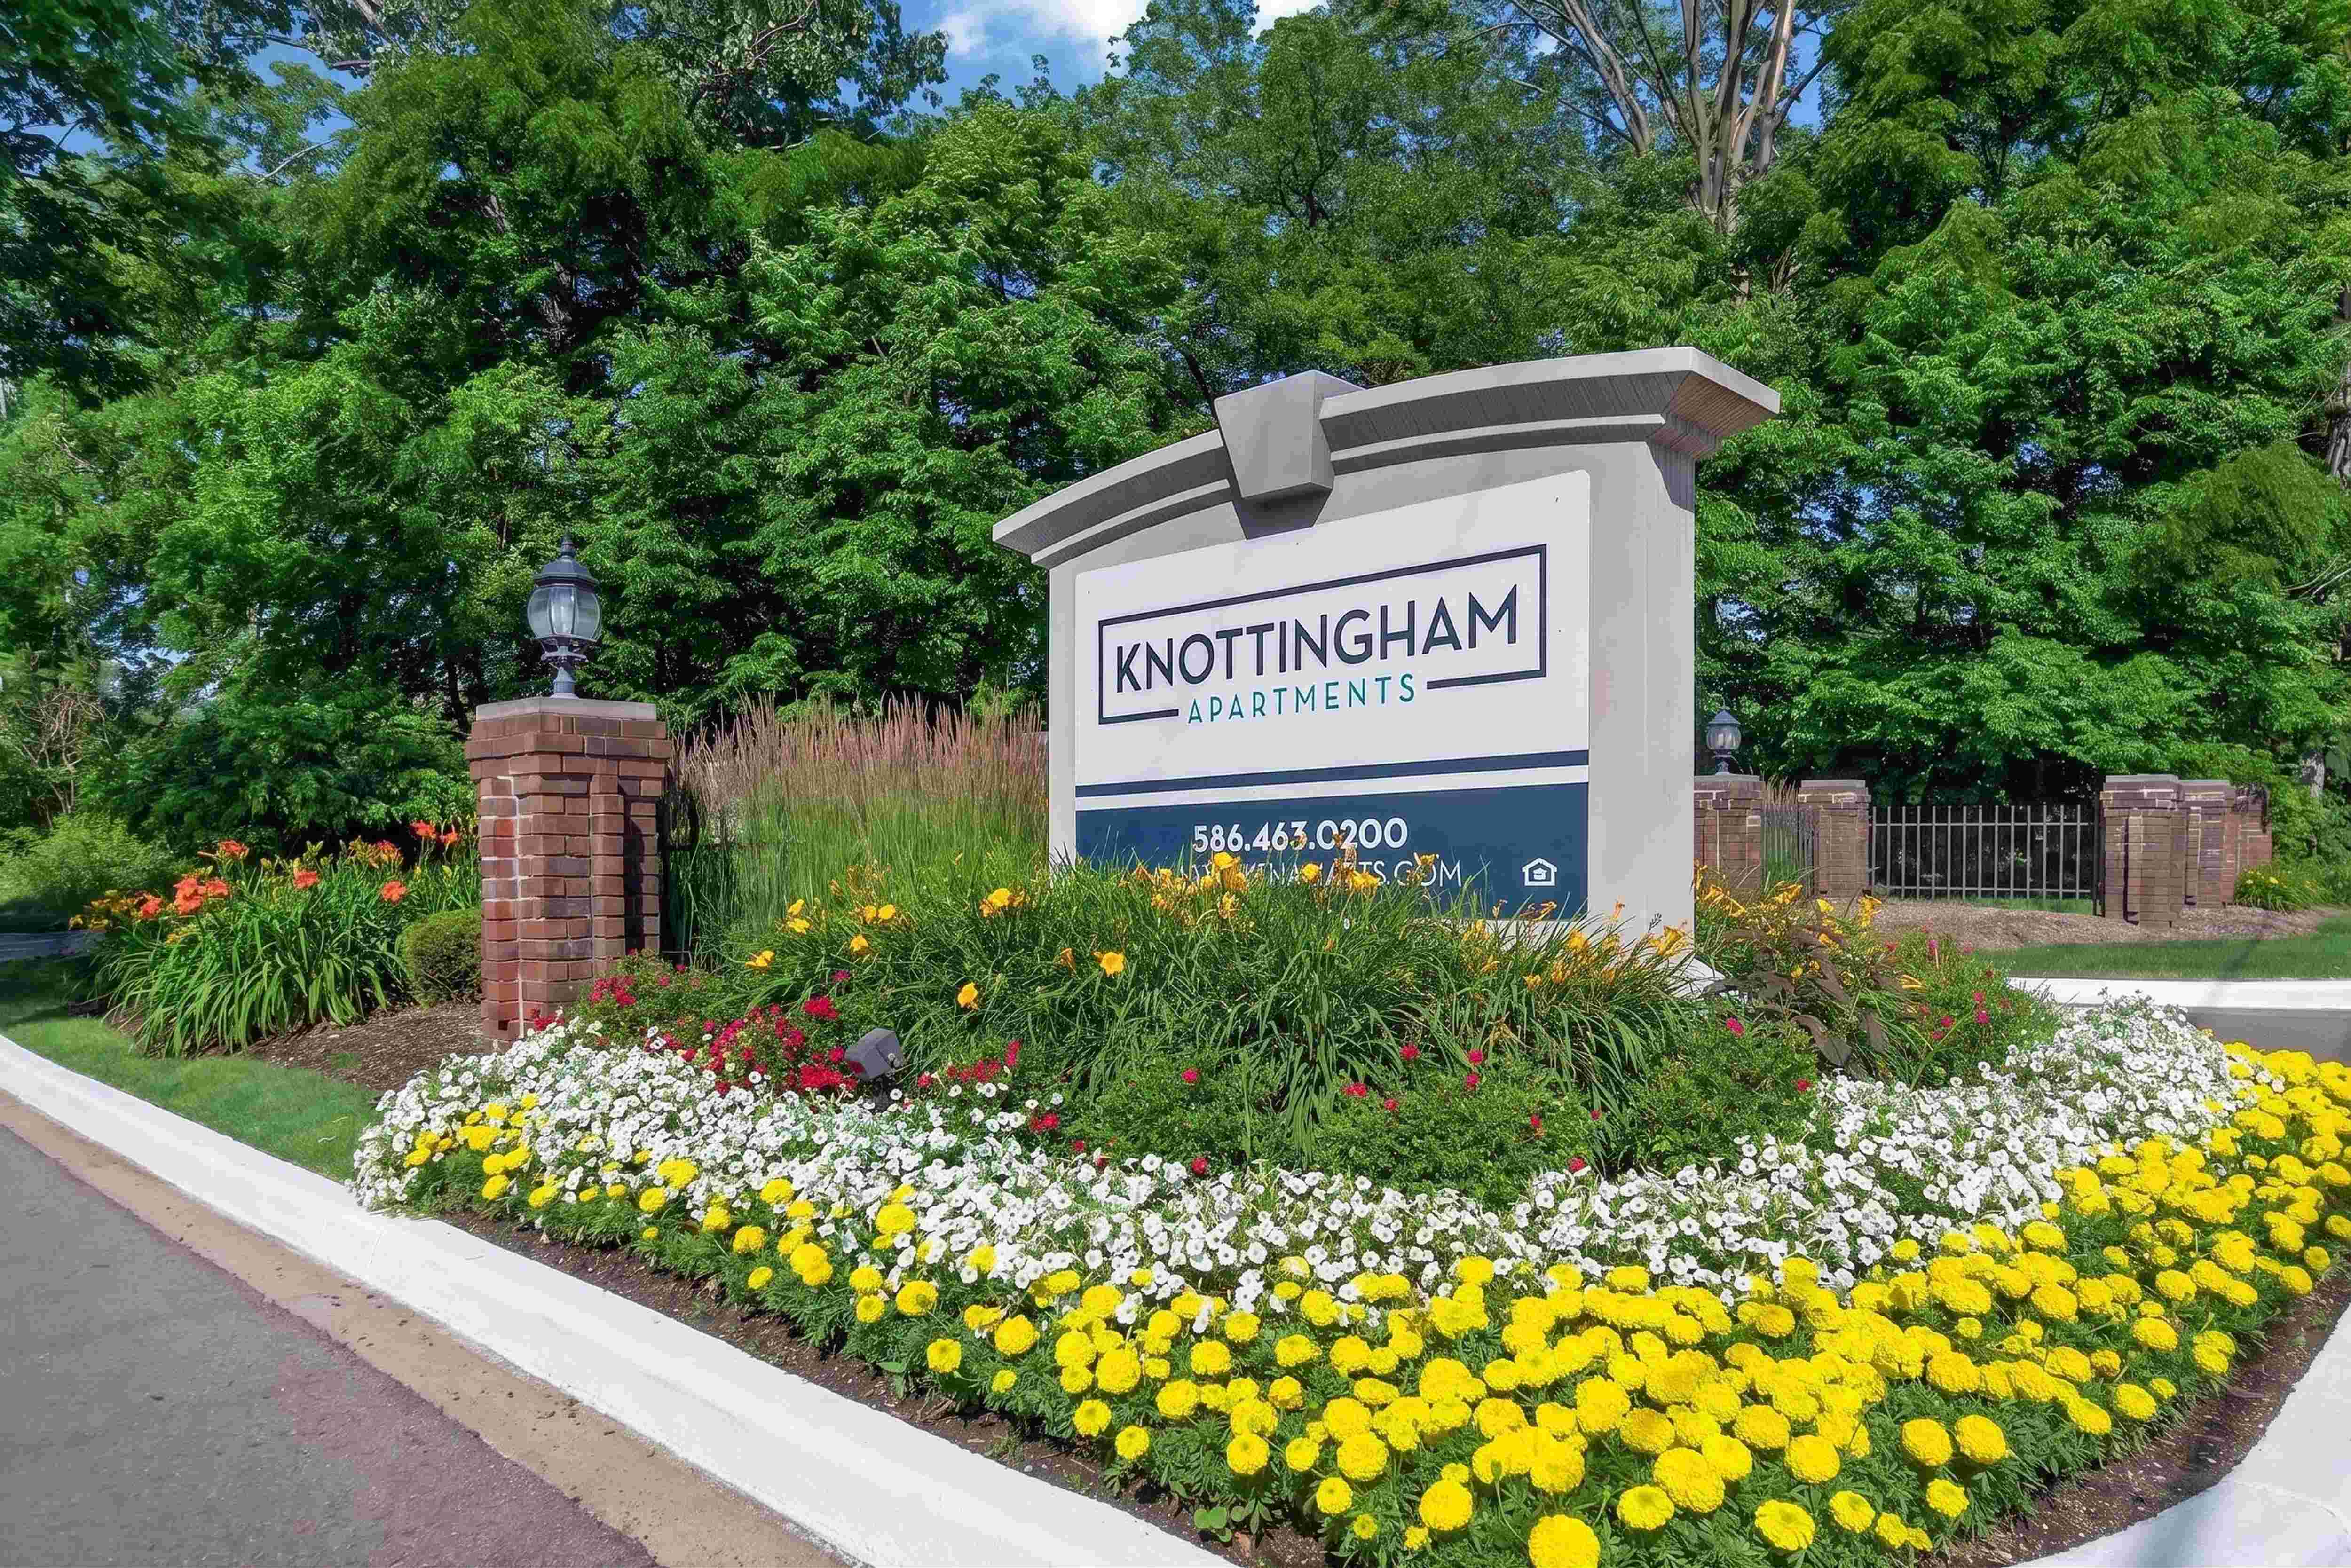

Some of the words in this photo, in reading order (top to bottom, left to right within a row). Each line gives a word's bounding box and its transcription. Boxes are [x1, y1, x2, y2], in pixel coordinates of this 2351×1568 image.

[1116, 583, 1517, 693] KNOTTINGHAM
[1187, 673, 1415, 724] APARTMENTS
[1193, 817, 1408, 853] 586.463.0200
